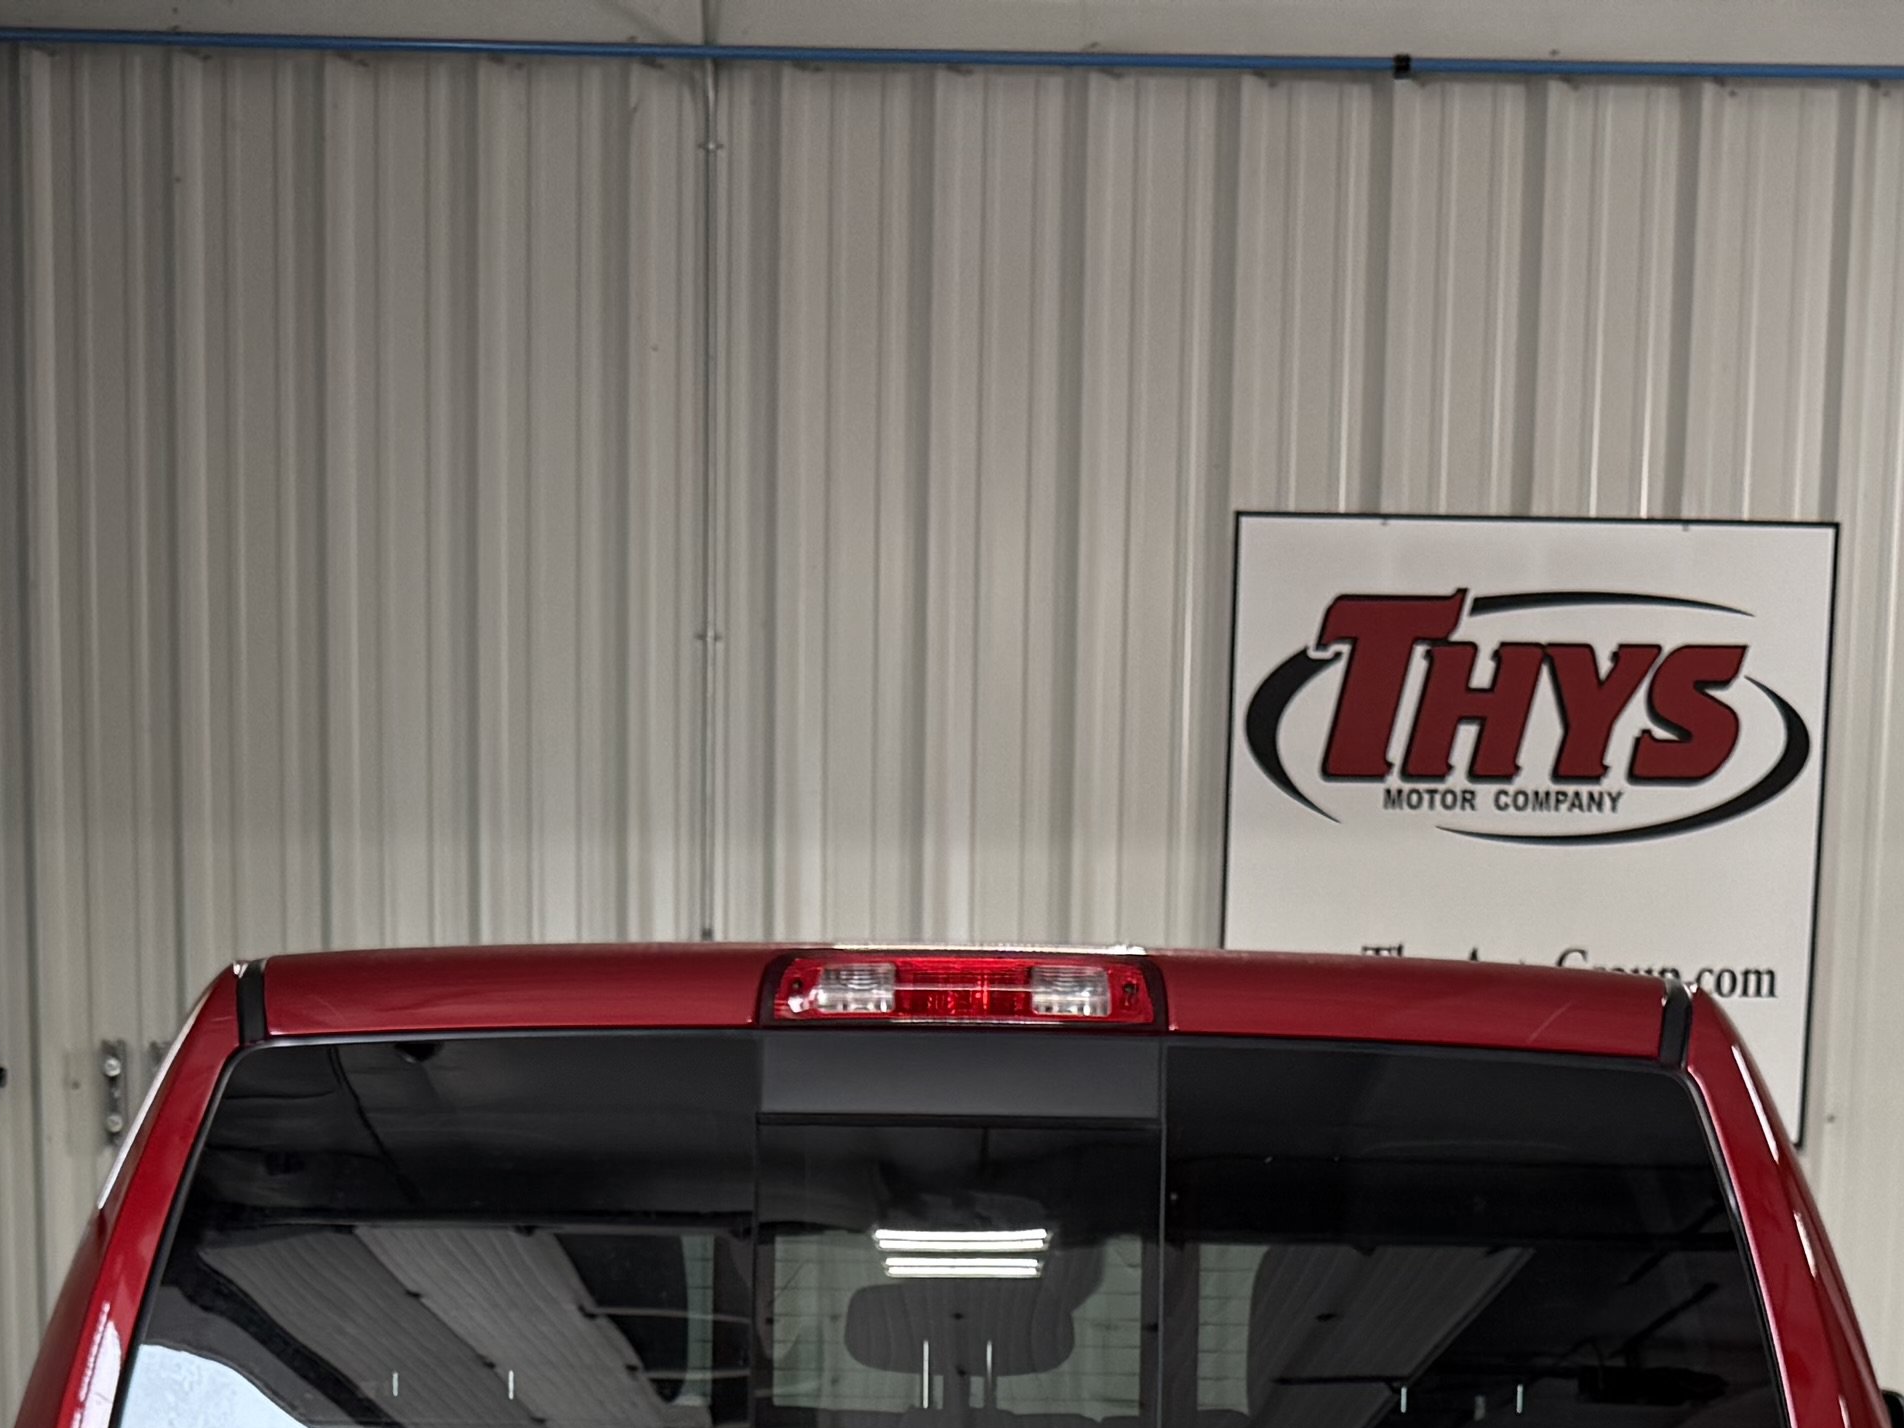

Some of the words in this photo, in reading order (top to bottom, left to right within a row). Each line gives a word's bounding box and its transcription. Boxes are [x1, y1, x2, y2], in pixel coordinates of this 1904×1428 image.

[1317, 586, 1749, 787] THYS
[1383, 787, 1477, 812] MOTOR
[1494, 789, 1624, 815] COMPANY
